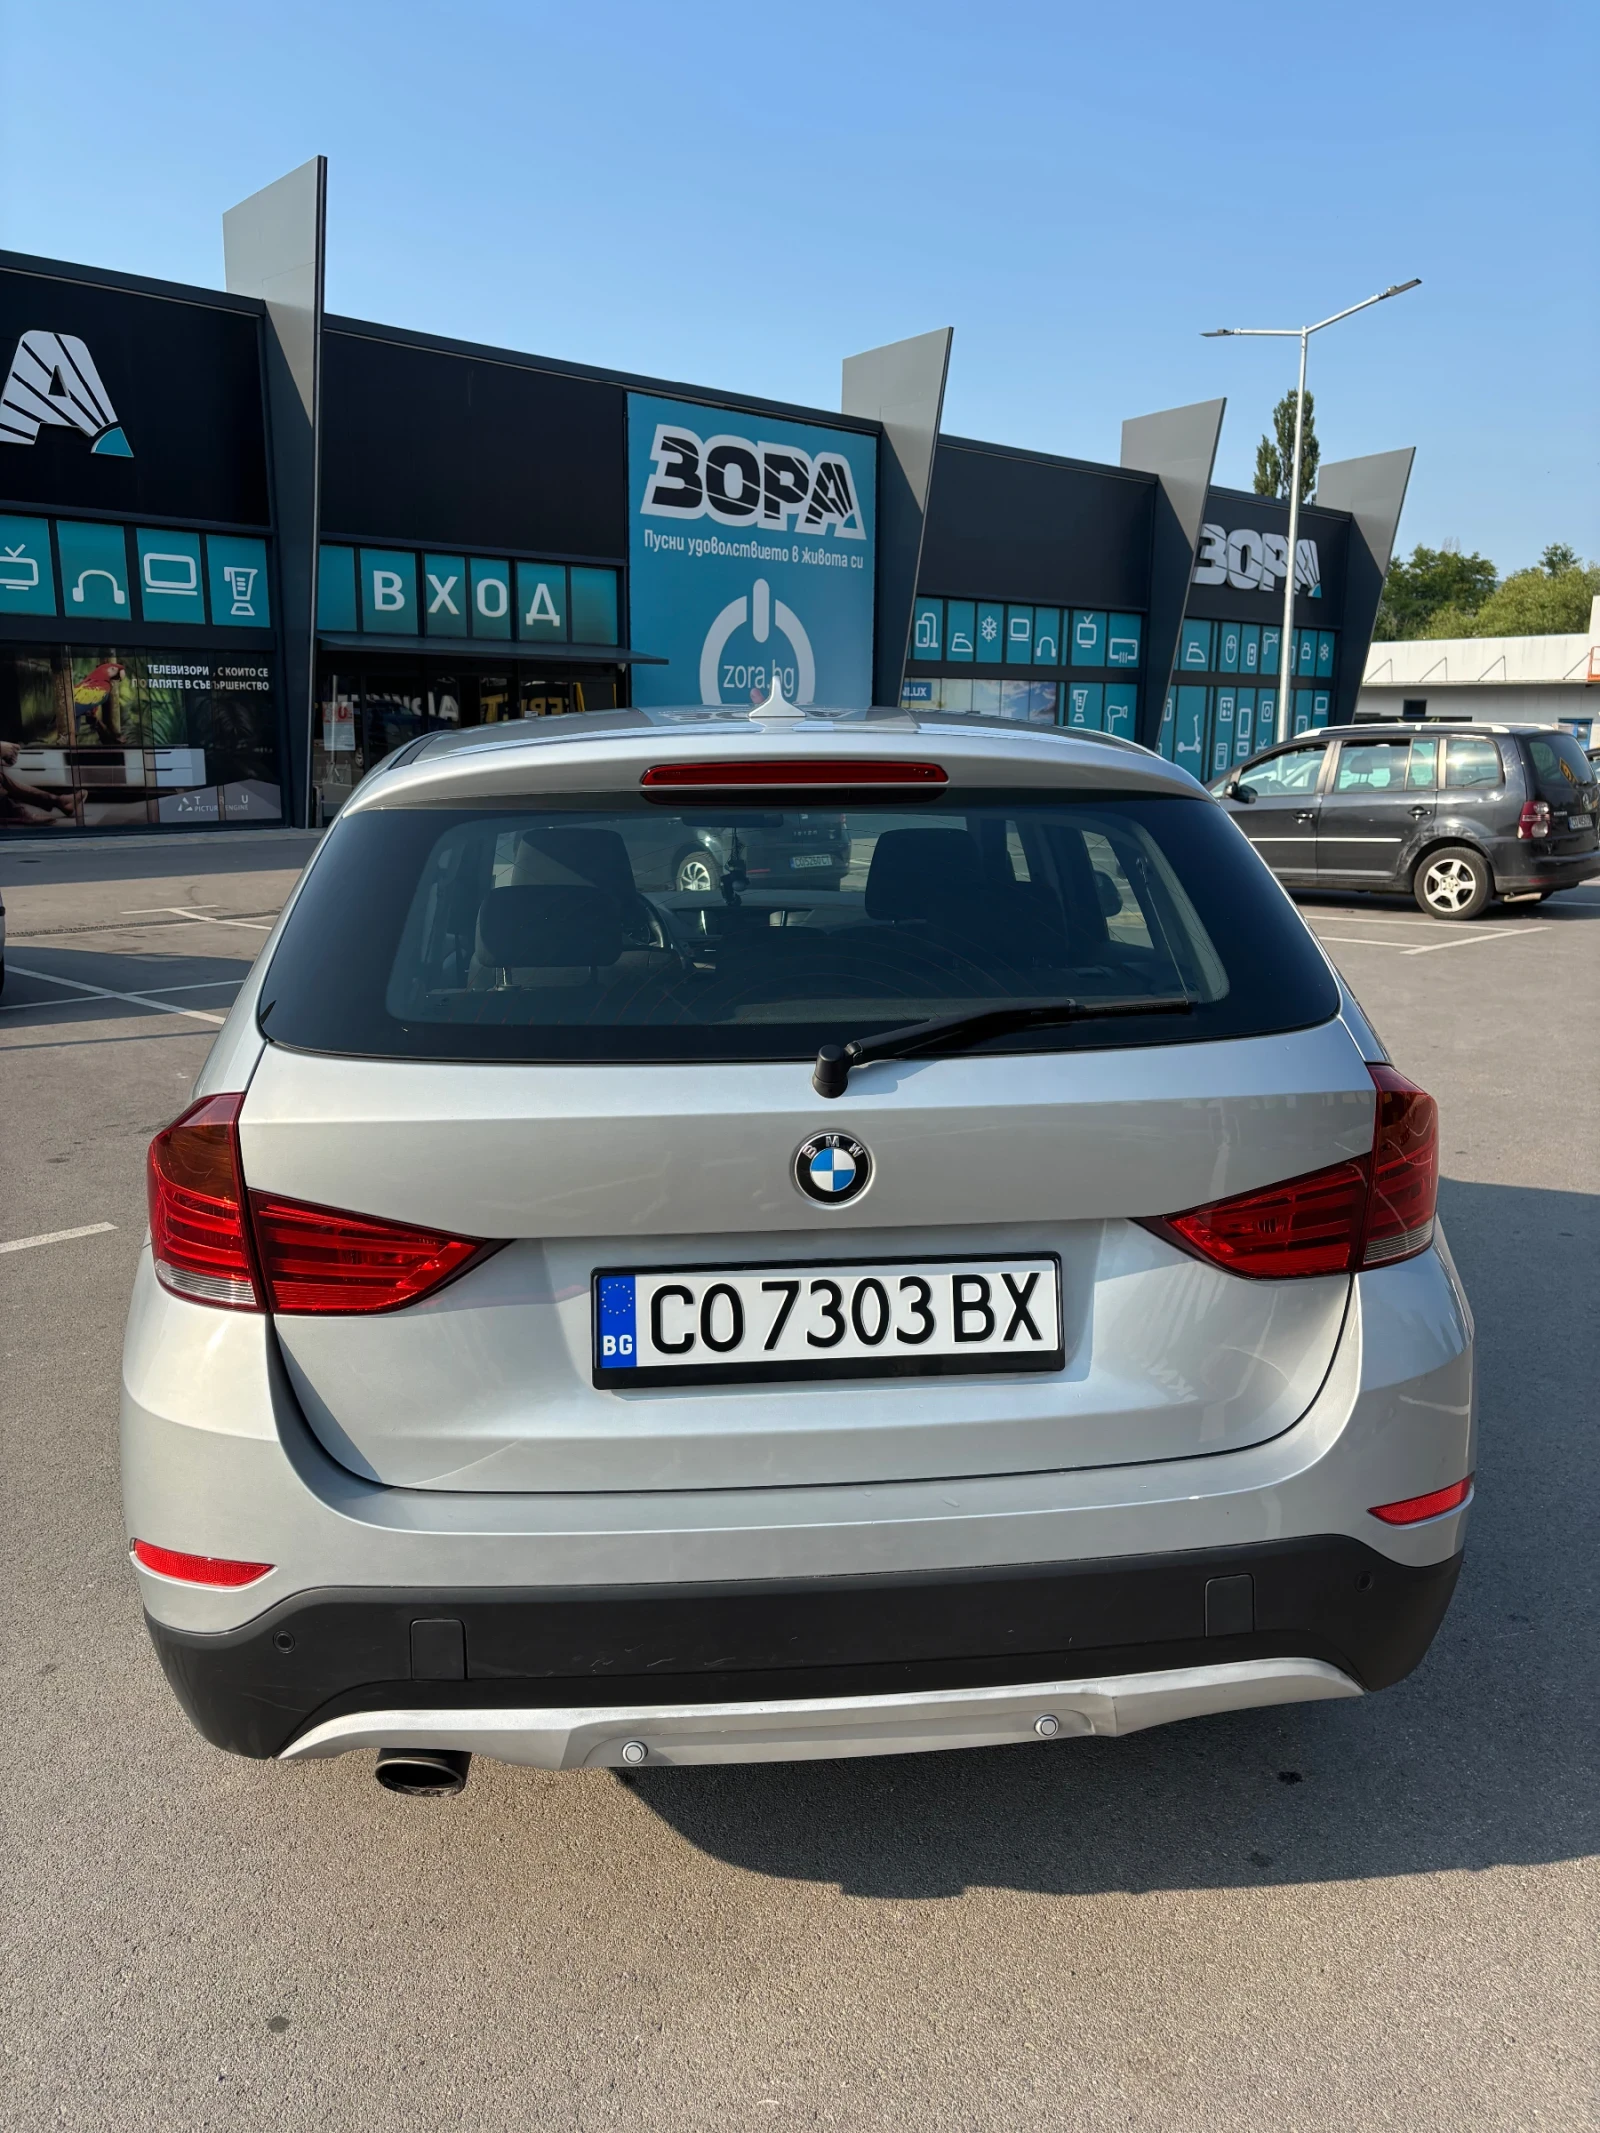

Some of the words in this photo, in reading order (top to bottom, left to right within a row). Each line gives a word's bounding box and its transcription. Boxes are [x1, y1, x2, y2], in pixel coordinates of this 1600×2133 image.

[640, 424, 867, 540] ЗОРА
[644, 529, 685, 552] Пусни
[688, 536, 789, 562] удоволствието
[791, 545, 799, 563] в
[801, 546, 848, 568] живота
[850, 555, 864, 569] си
[1191, 523, 1322, 598] ЗОРА
[373, 570, 560, 626] ВХОД
[185, 679, 192, 689] В
[258, 668, 269, 677] СЕ
[723, 659, 795, 697] zora.bg
[194, 805, 220, 813] PICTUR
[802, 1135, 864, 1160] BMW
[650, 1283, 745, 1354] CO
[761, 1275, 935, 1351] 7303
[951, 1272, 1043, 1344] BX
[603, 1334, 633, 1356] BG
